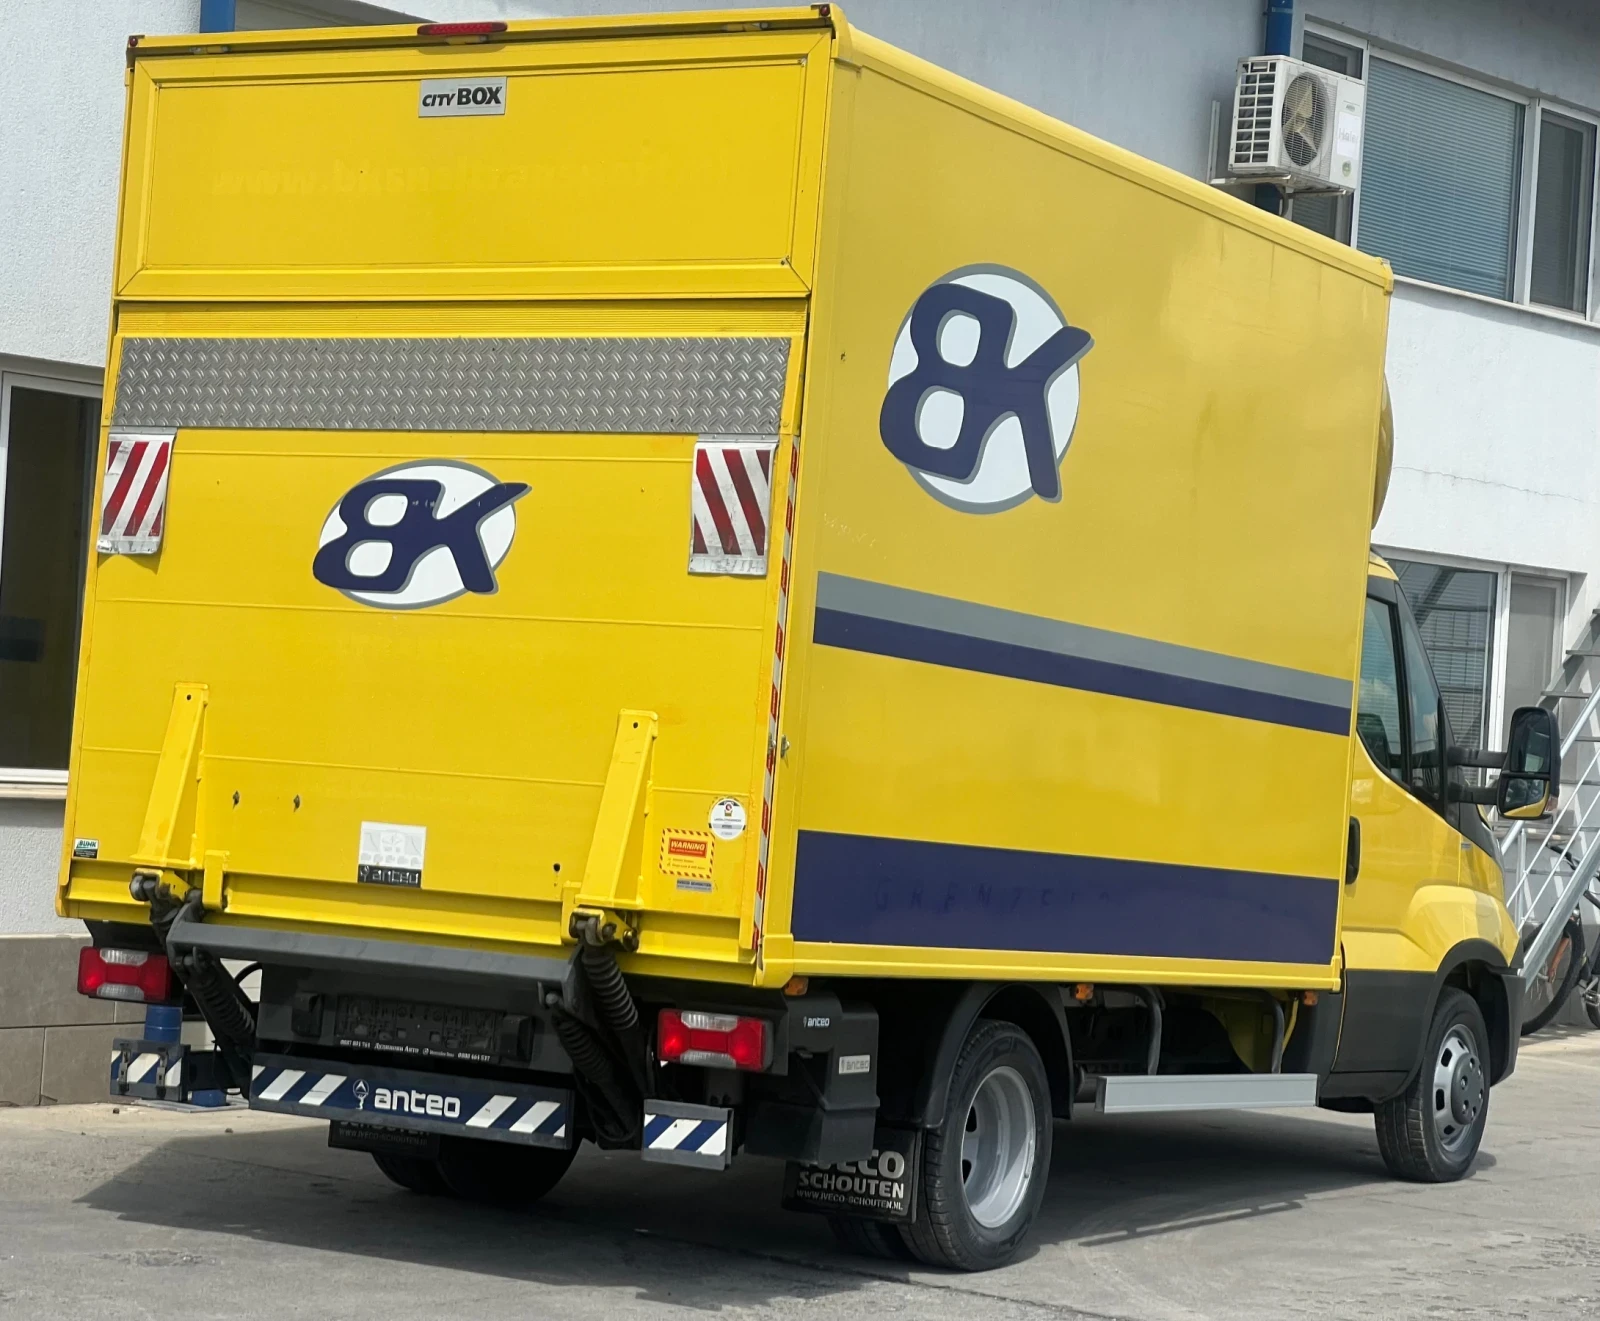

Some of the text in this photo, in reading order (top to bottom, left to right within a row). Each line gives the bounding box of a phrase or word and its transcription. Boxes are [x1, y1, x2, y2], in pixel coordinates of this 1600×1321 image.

[422, 86, 503, 107] CITY BOX
[671, 840, 705, 851] WARNING
[807, 1016, 830, 1027] anteo
[846, 1057, 870, 1071] anteo
[374, 1087, 461, 1118] anteo
[799, 1171, 904, 1199] SCHOUTEN
